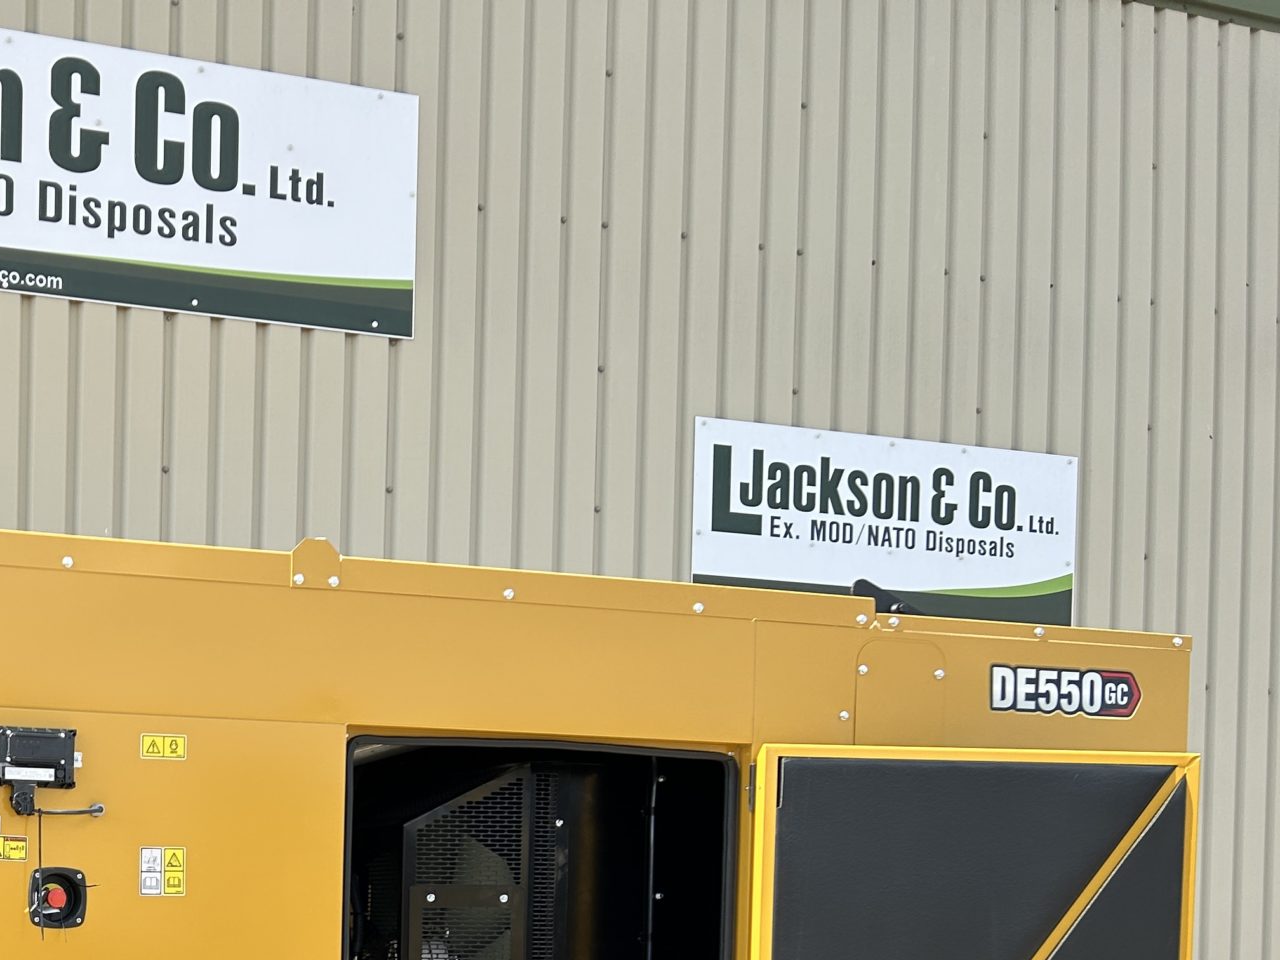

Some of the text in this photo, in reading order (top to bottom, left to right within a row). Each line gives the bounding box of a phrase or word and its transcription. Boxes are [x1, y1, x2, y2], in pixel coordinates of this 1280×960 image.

[49, 57, 110, 173] &
[134, 70, 256, 196] Co.
[270, 165, 336, 207] Ltd.
[38, 180, 238, 247] Disposals
[931, 467, 958, 526] &
[969, 471, 1023, 531] Co.
[1029, 515, 1059, 535] Ltd.
[770, 516, 1015, 558] Ex. MOD/NATO Disposals
